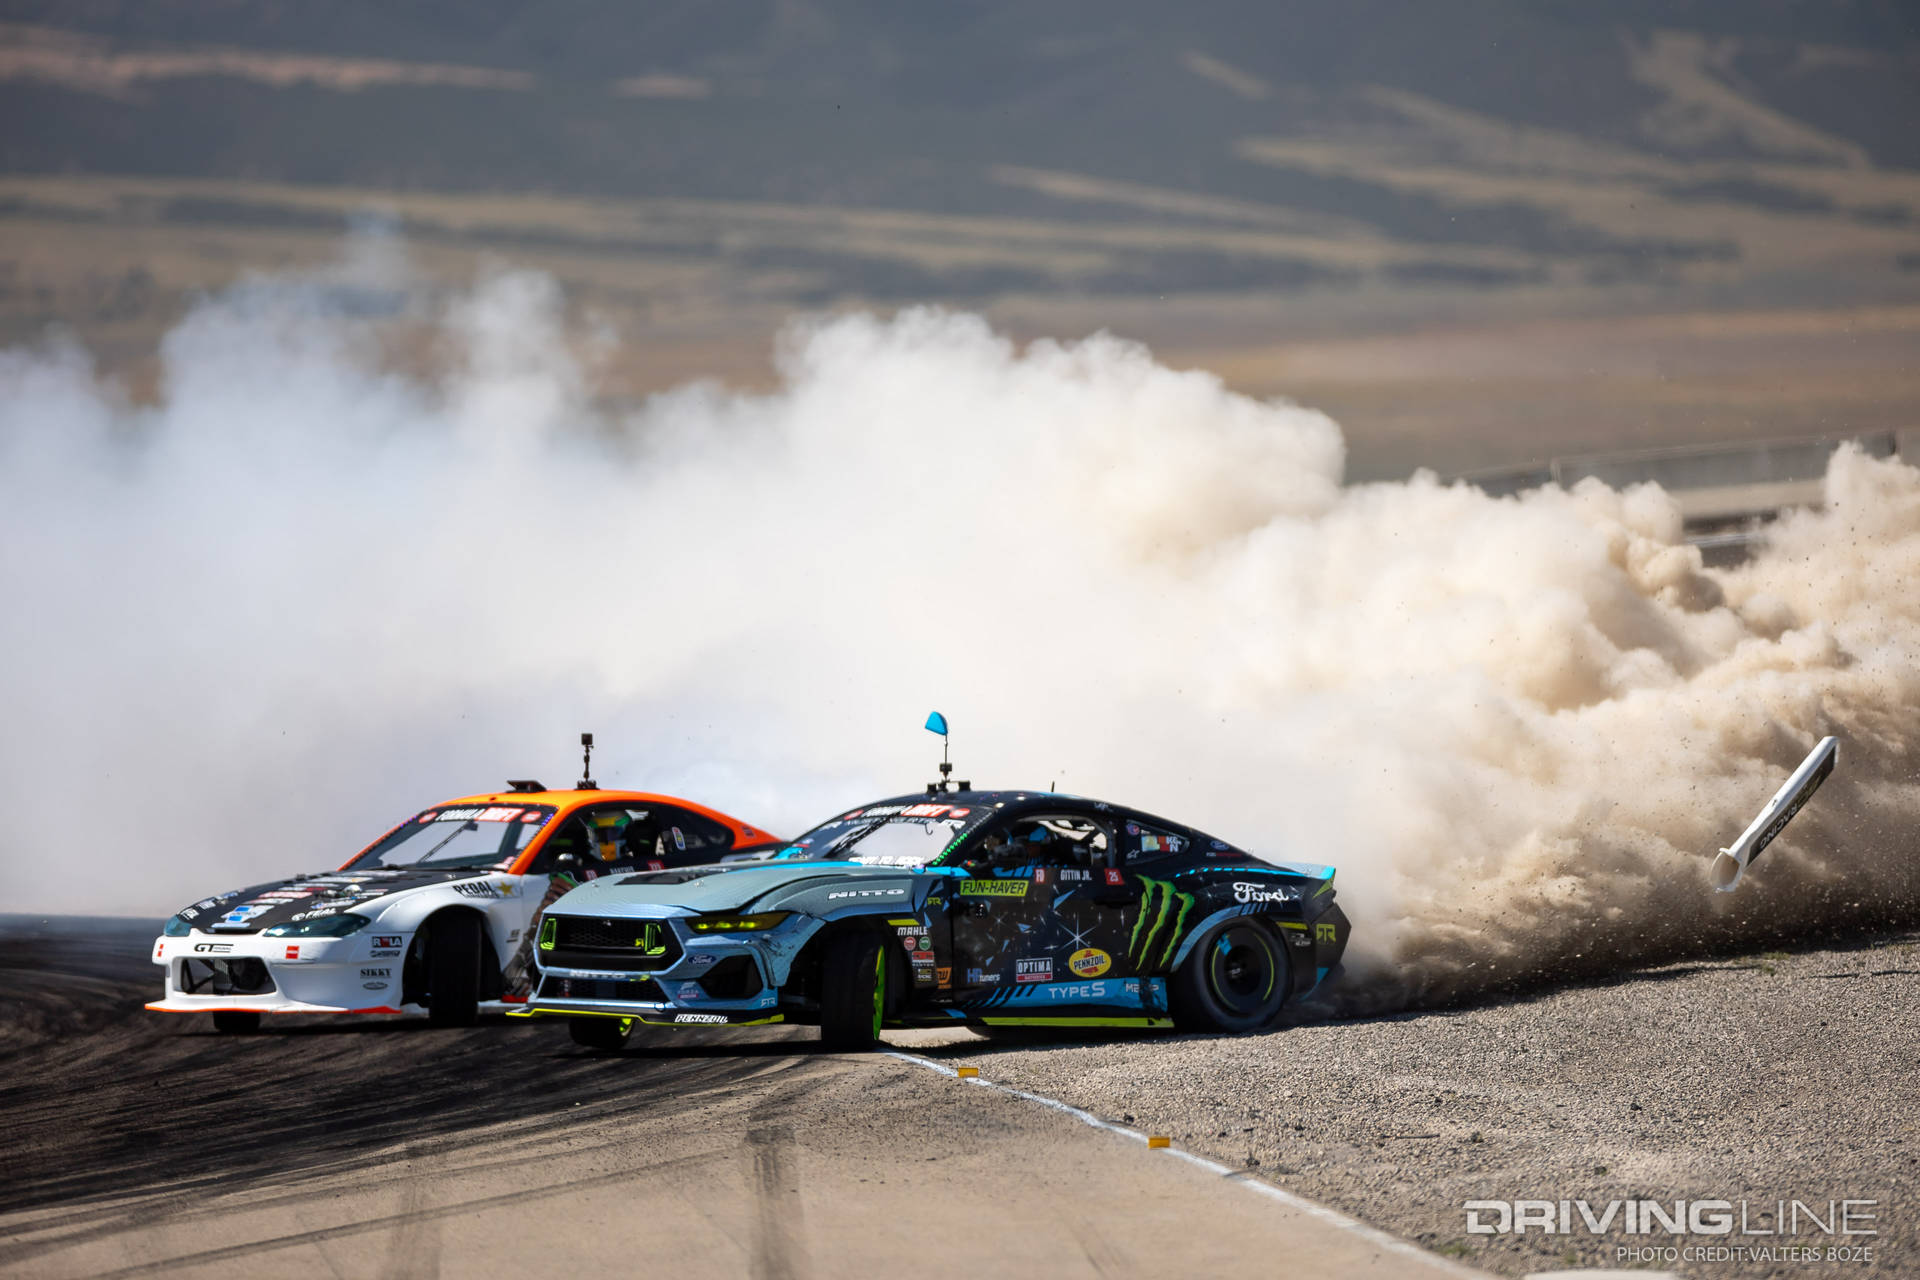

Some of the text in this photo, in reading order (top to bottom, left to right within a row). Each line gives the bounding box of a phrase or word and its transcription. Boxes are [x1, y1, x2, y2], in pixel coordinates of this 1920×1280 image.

[1759, 803, 1798, 849] RACING
[1060, 870, 1092, 880] GITTIN JR.
[963, 882, 1025, 894] FUN-HAVER
[1233, 882, 1289, 903] Ford
[828, 889, 905, 900] NITTO
[897, 927, 928, 936] MAHLE
[1018, 961, 1051, 973] OPTIMA
[1073, 956, 1107, 970] PENNZOIL
[360, 969, 391, 978] SIKKY
